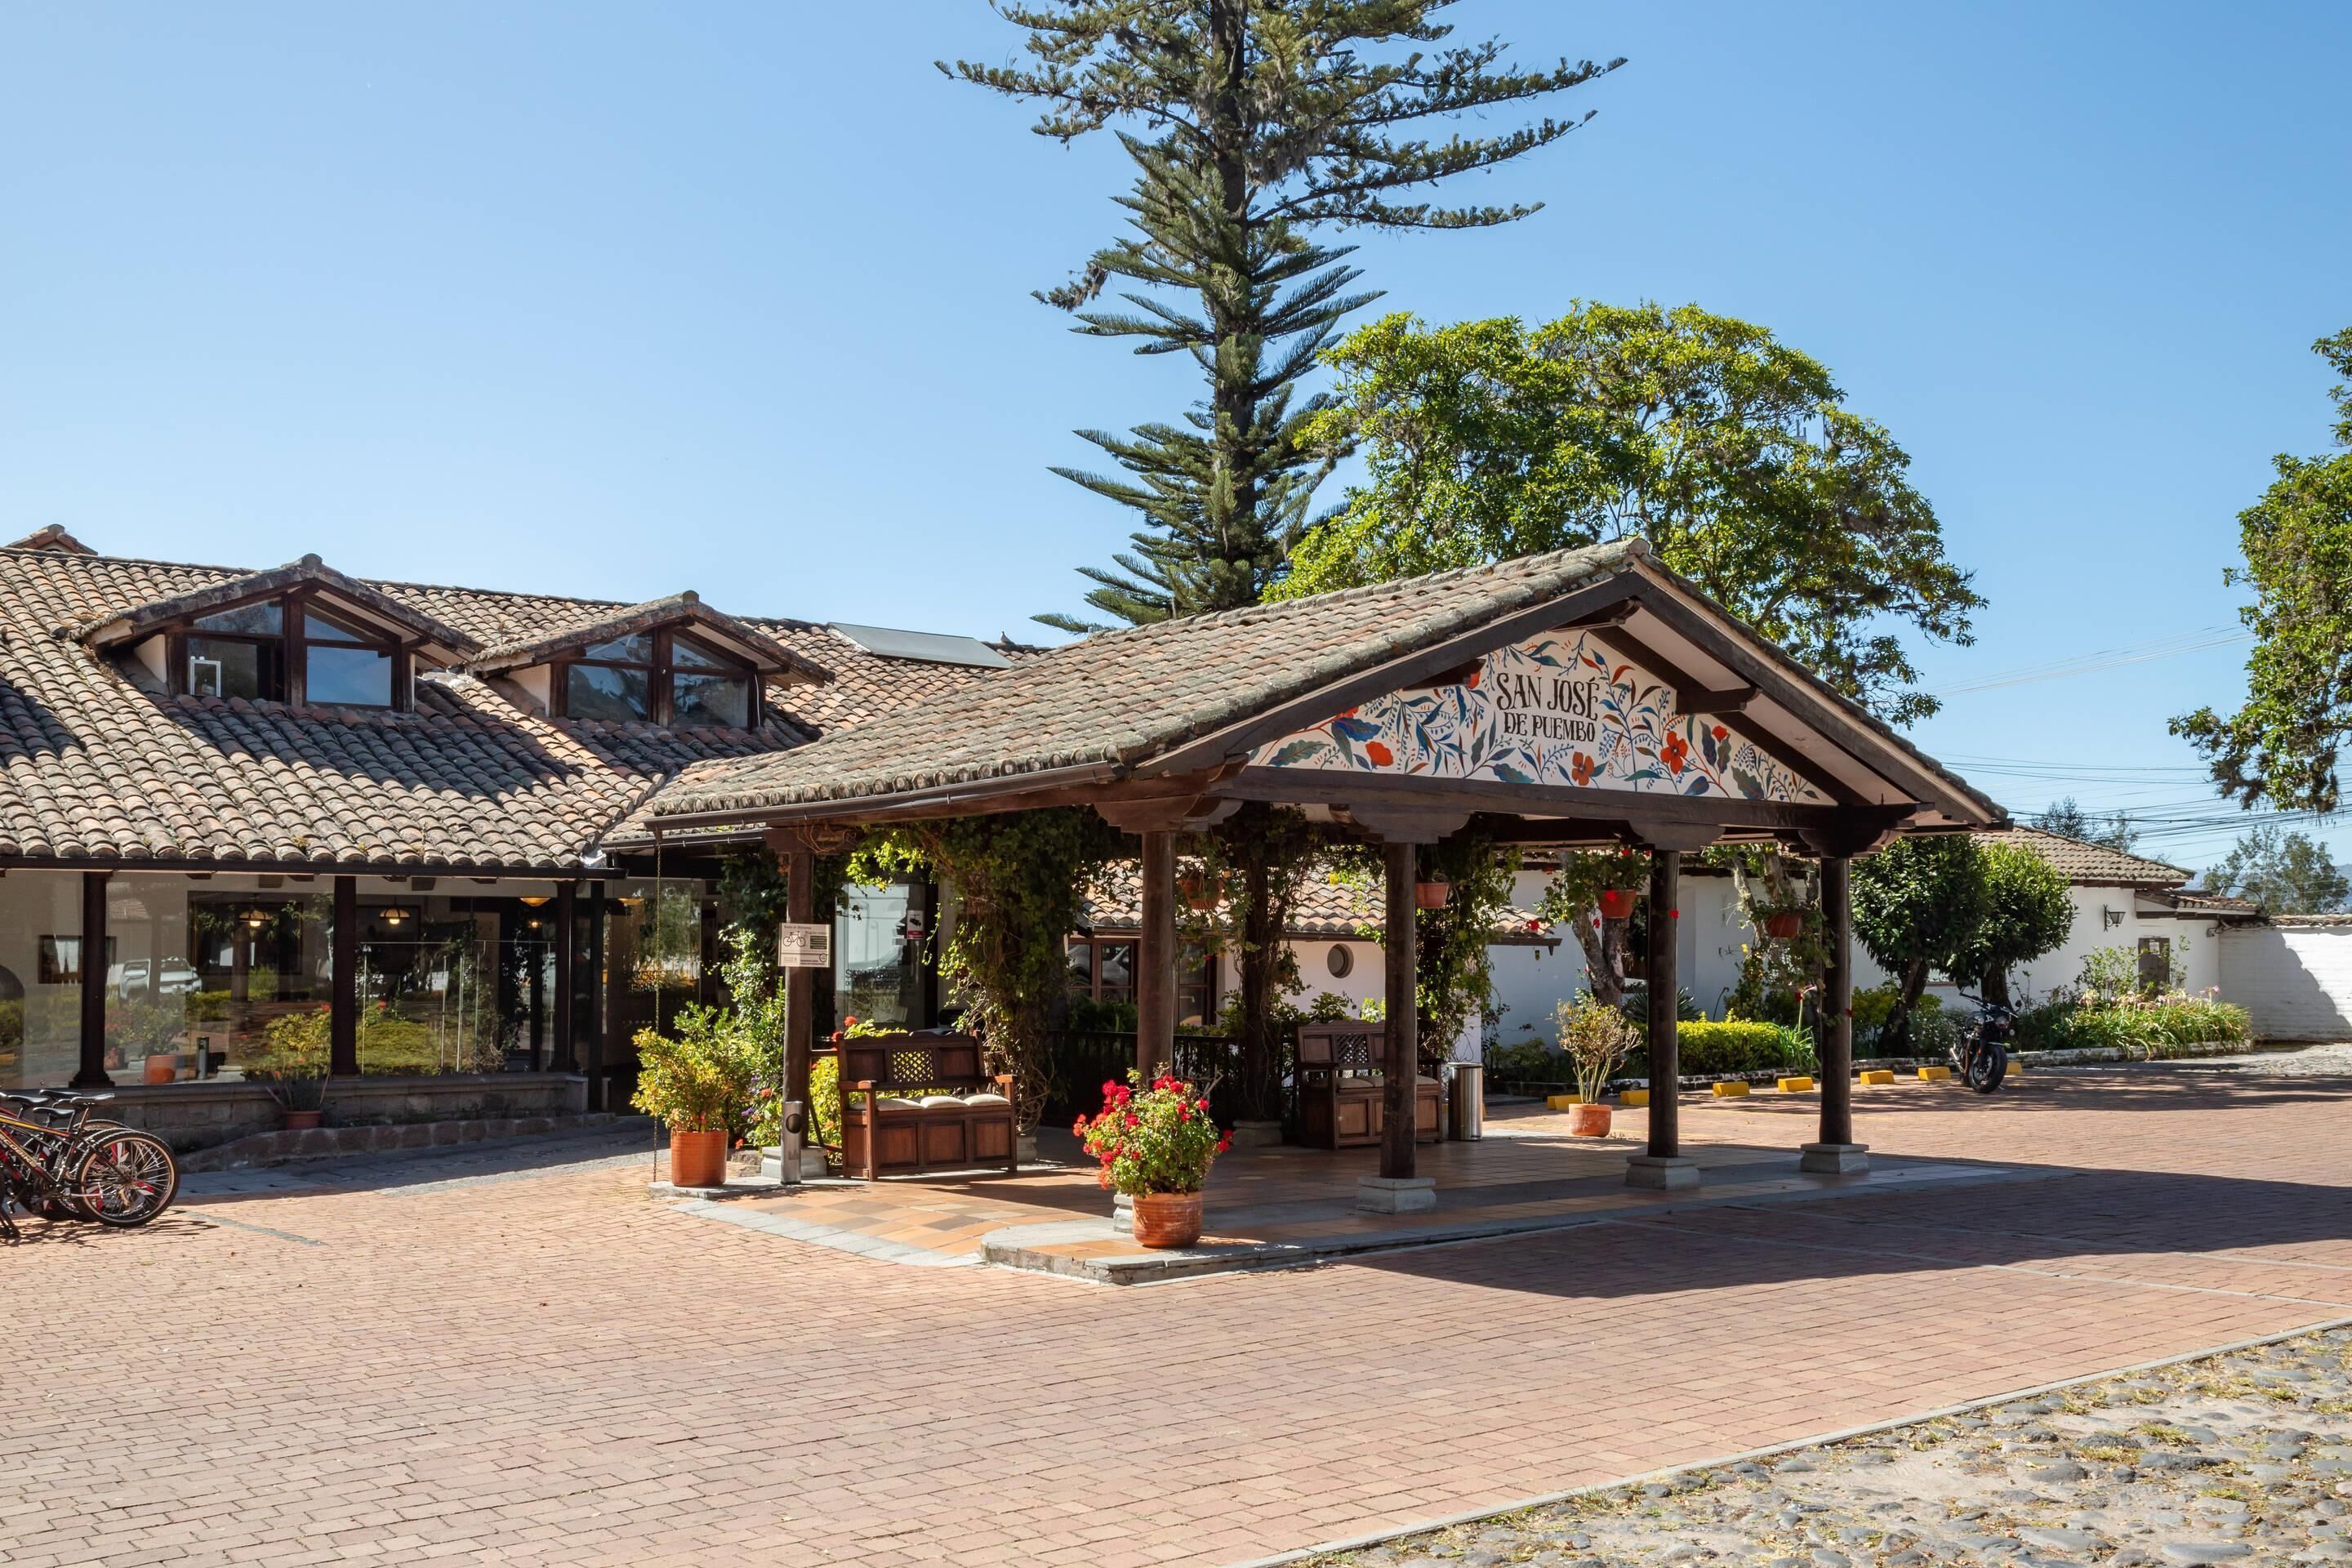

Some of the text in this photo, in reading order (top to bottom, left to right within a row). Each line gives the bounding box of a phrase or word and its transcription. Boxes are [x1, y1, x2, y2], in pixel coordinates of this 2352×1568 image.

[1496, 672, 1600, 721] SAN JOSÉ
[1503, 711, 1596, 742] DE PUEMBO
